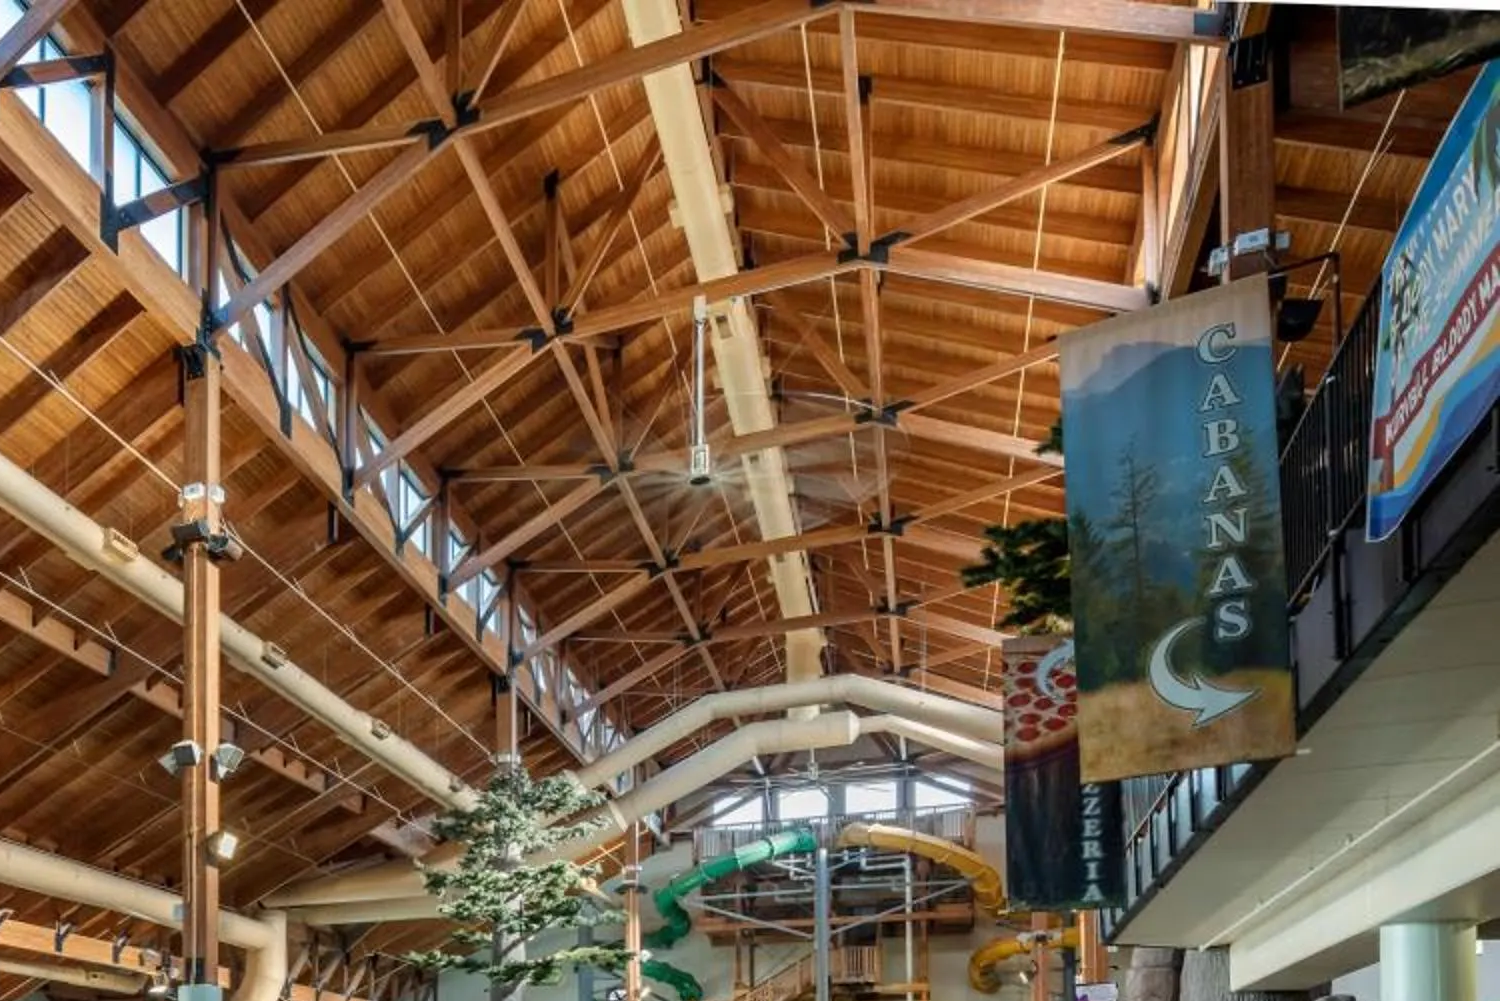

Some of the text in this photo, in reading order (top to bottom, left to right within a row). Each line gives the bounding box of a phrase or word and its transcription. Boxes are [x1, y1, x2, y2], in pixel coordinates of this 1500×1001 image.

[1432, 160, 1478, 260] MARY
[1432, 290, 1477, 376] BLOODY
[1197, 322, 1253, 639] CABANAS
